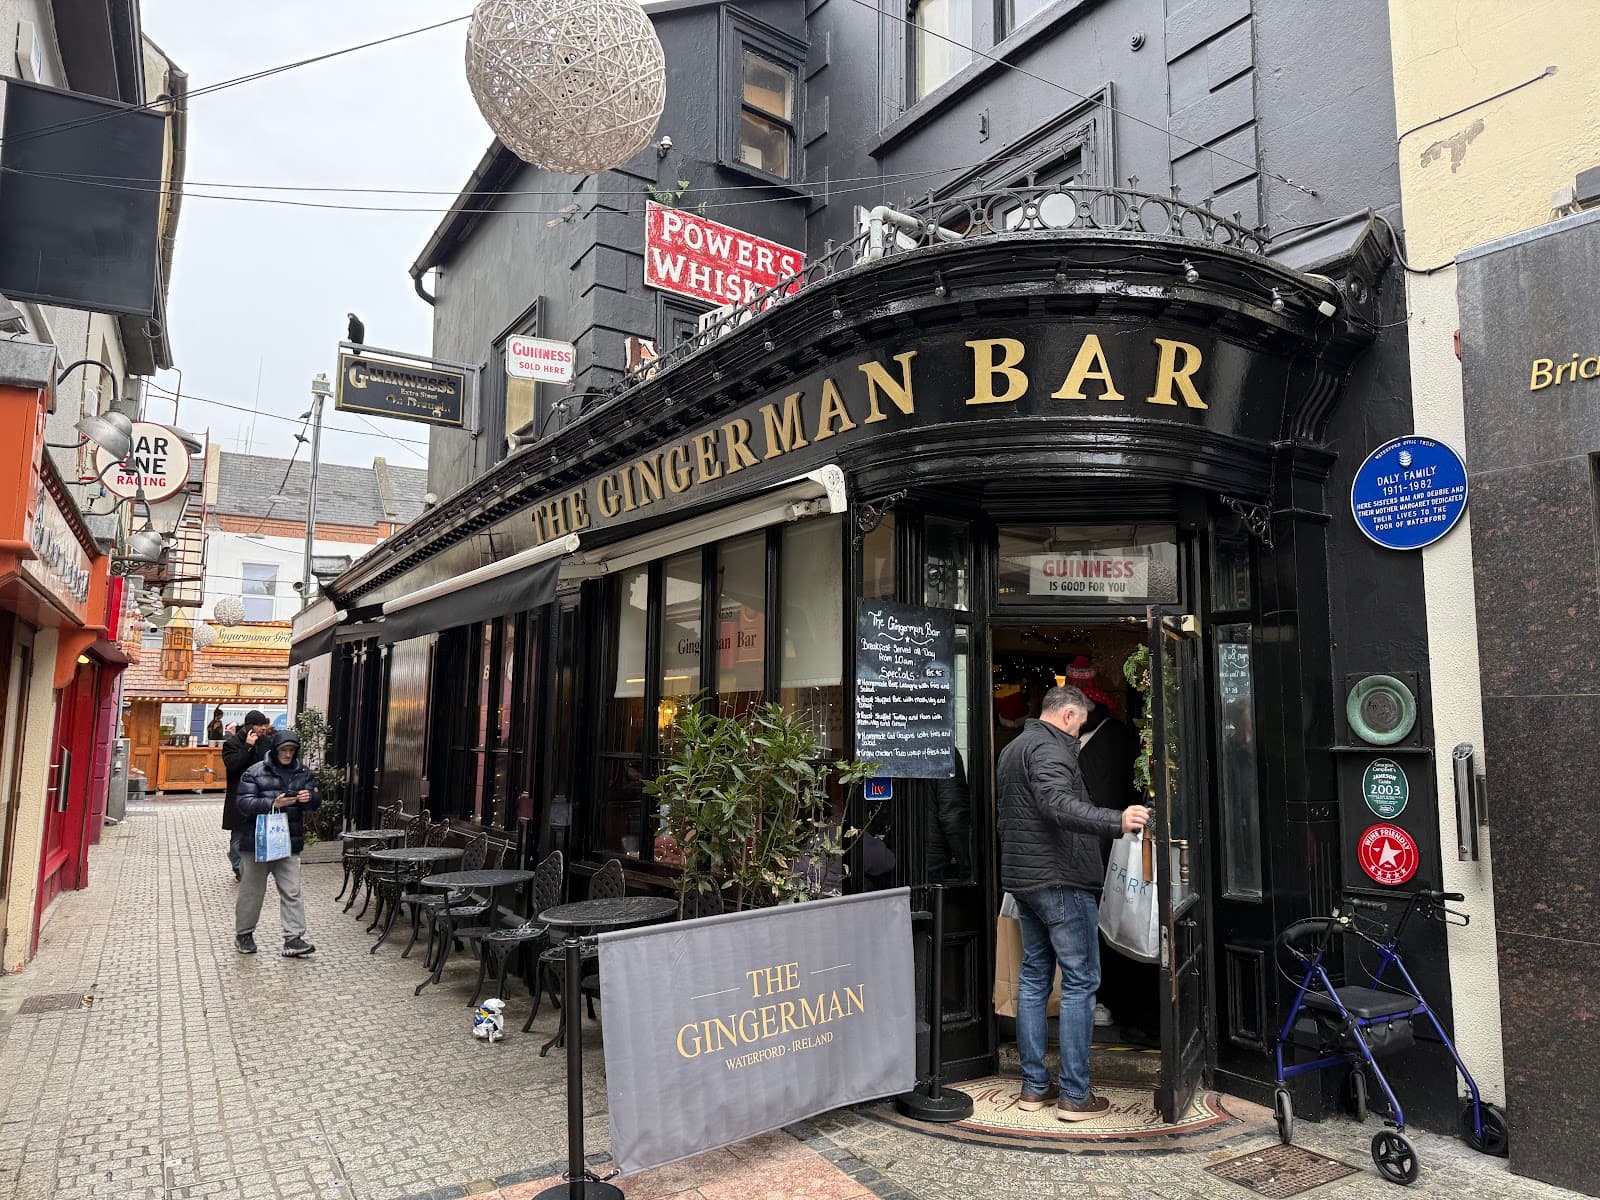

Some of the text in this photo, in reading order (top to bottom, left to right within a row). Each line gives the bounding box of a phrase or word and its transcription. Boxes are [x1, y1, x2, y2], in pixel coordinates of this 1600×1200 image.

[661, 211, 797, 280] POWER'S
[650, 247, 793, 309] WHISK
[512, 341, 572, 363] GUINNESS
[519, 361, 565, 375] SOLD HERE
[134, 435, 169, 456] AR
[530, 487, 591, 545] THE
[598, 350, 918, 519] GINGERMAN
[964, 334, 1209, 410] BAR
[1377, 465, 1437, 487] DALY FAMILY
[1357, 485, 1464, 510] HERE SISTERS MAI AND DEBBIE AND
[1383, 478, 1433, 497] 1911-1982
[1358, 494, 1463, 518] THEIR MOTHER MARGARET DEDICATED
[1373, 505, 1447, 524] THEIR LIVES TO THE
[1375, 514, 1447, 531] POOR OF WATERFORD
[1042, 559, 1135, 579] GUINNESS
[1049, 581, 1126, 593] IS GOOD FOR YOU
[868, 610, 941, 638] The Gingerman Bar
[737, 631, 757, 648] Bar
[860, 637, 891, 653] Breakfast
[921, 647, 936, 661] Day
[878, 666, 915, 681] Specials
[1372, 773, 1397, 781] JAMESON
[1370, 784, 1401, 796] 2003
[1364, 828, 1411, 851] WINE FRIENDLY
[746, 961, 801, 999] THE
[675, 983, 865, 1059] GINGERMAN
[725, 1044, 786, 1071] WATERFORD
[792, 1031, 833, 1053] IRELAND
